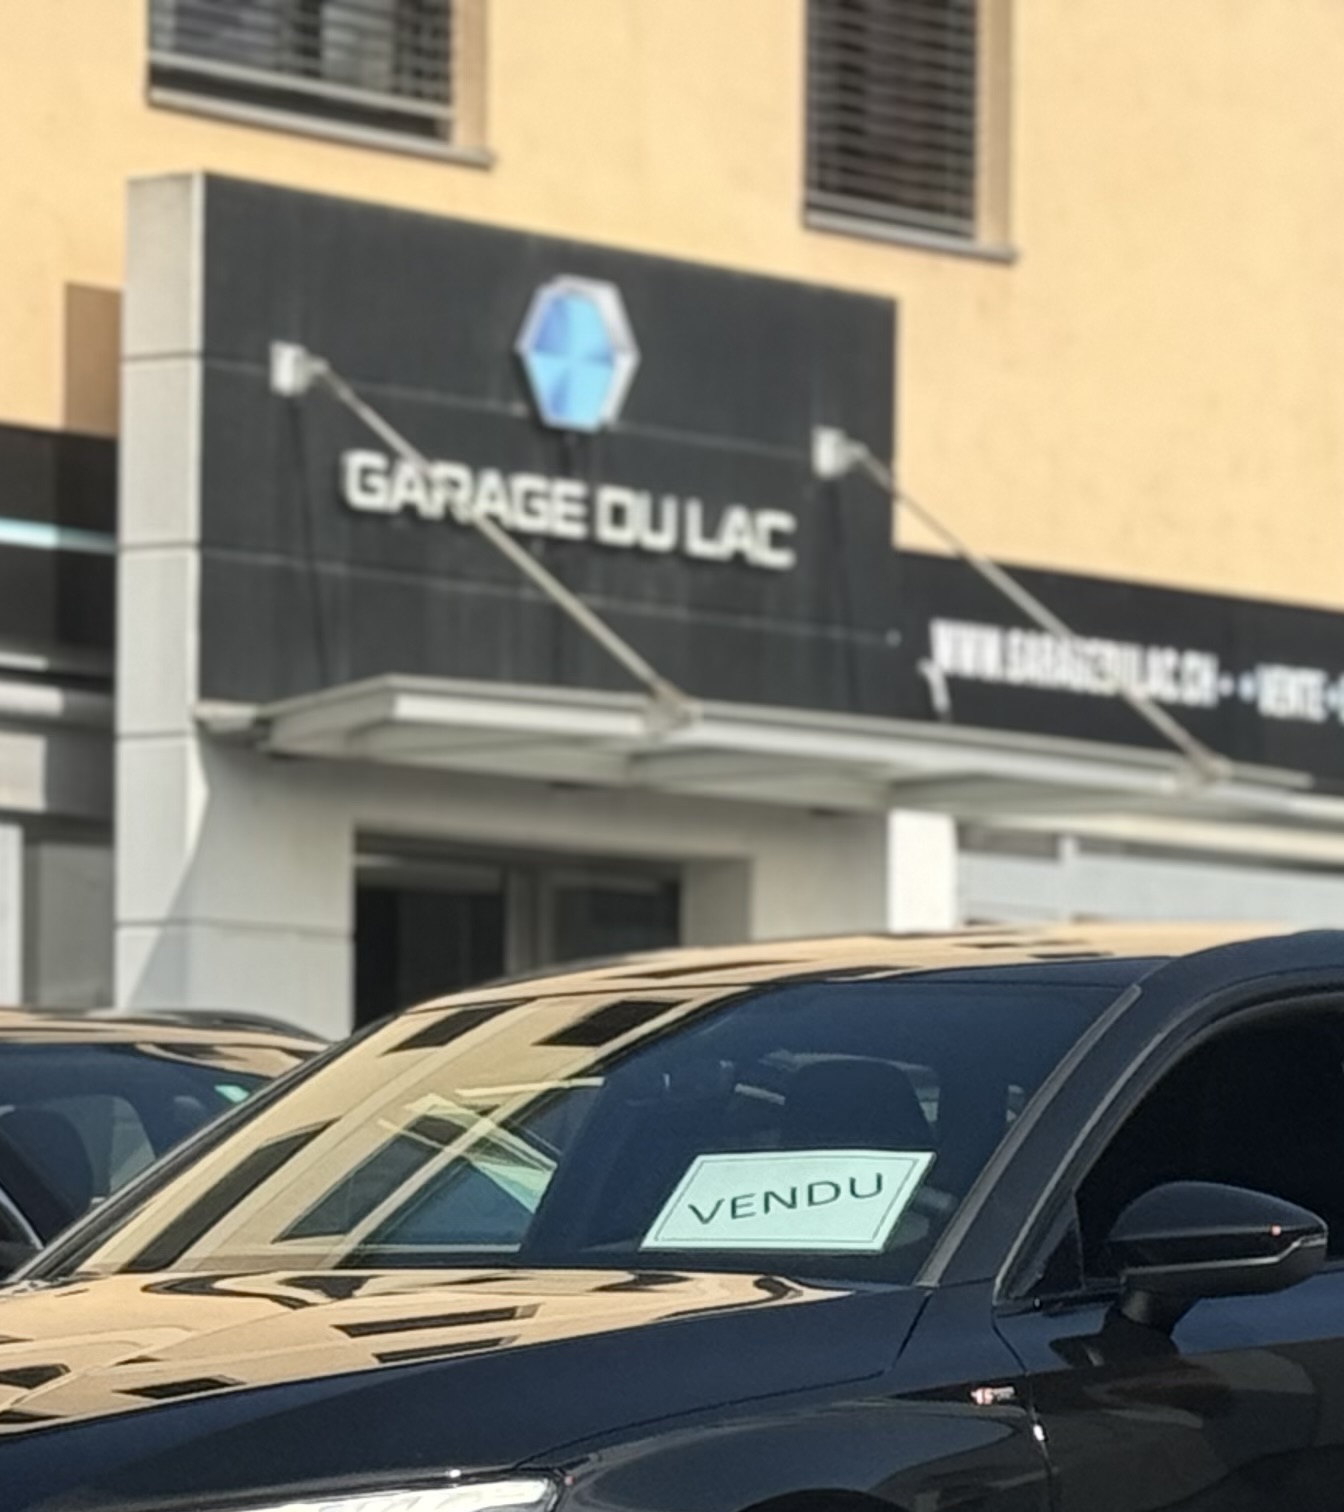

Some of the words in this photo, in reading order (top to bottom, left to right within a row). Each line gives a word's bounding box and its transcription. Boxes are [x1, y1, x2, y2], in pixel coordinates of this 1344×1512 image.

[342, 449, 588, 539] GARAGE
[594, 484, 677, 551] DU
[684, 497, 796, 570] LAC
[688, 1172, 884, 1225] VENDU
